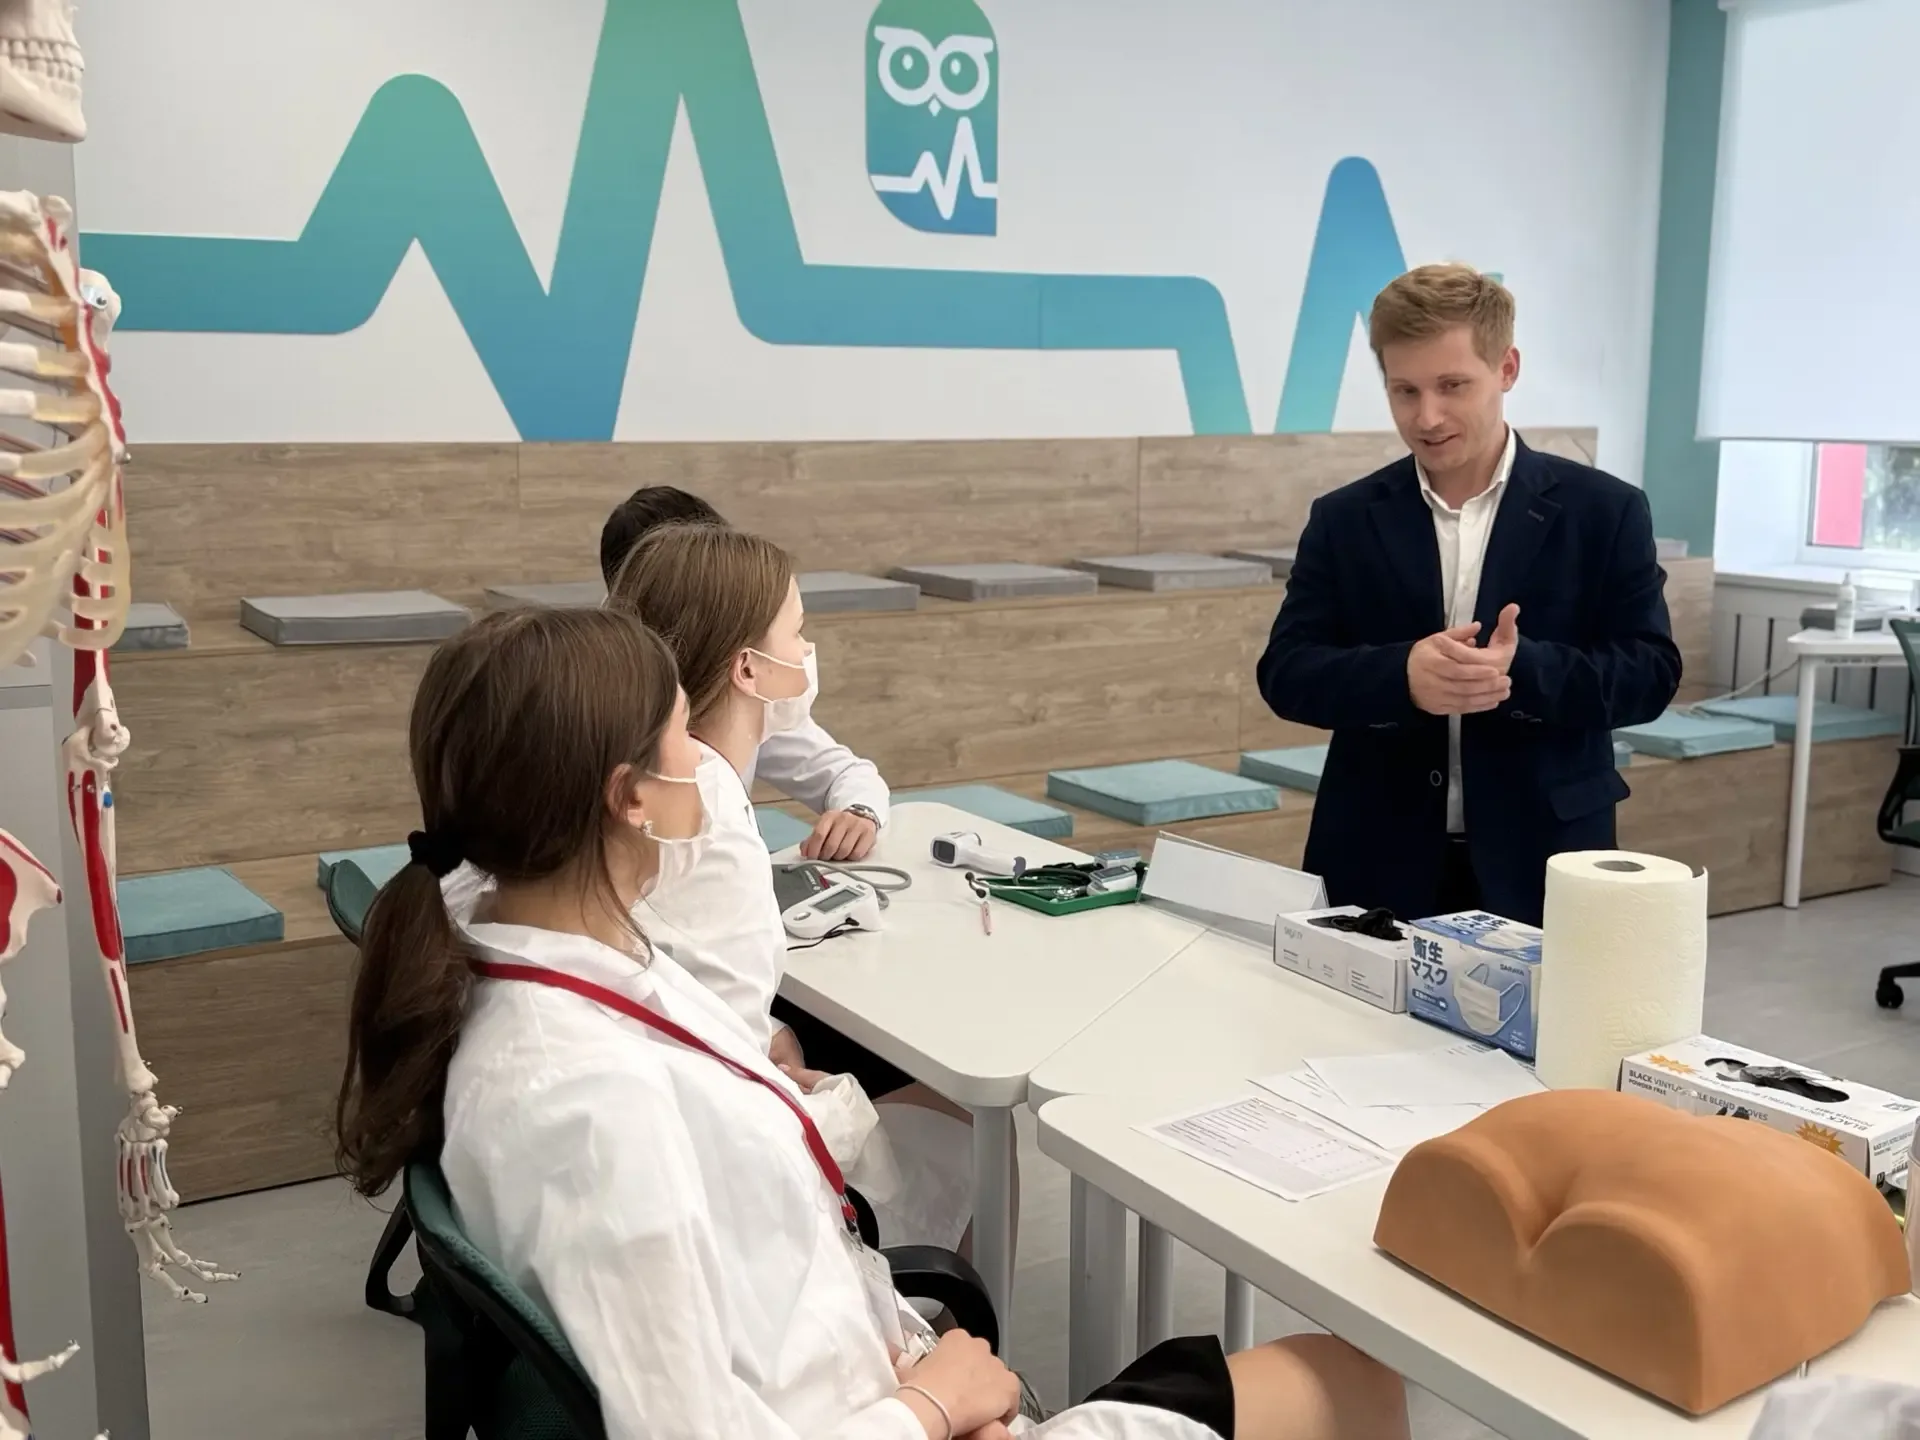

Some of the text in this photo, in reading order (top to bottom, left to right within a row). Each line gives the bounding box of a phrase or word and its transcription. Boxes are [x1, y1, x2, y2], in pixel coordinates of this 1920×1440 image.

[1413, 935, 1443, 965] 衛生
[1410, 957, 1447, 985] マスク
[1628, 1079, 1667, 1096] POWDER FREE
[1629, 1069, 1653, 1084] BLACK
[1709, 1095, 1735, 1110] BLEND
[1828, 1115, 1868, 1131] BLACK
